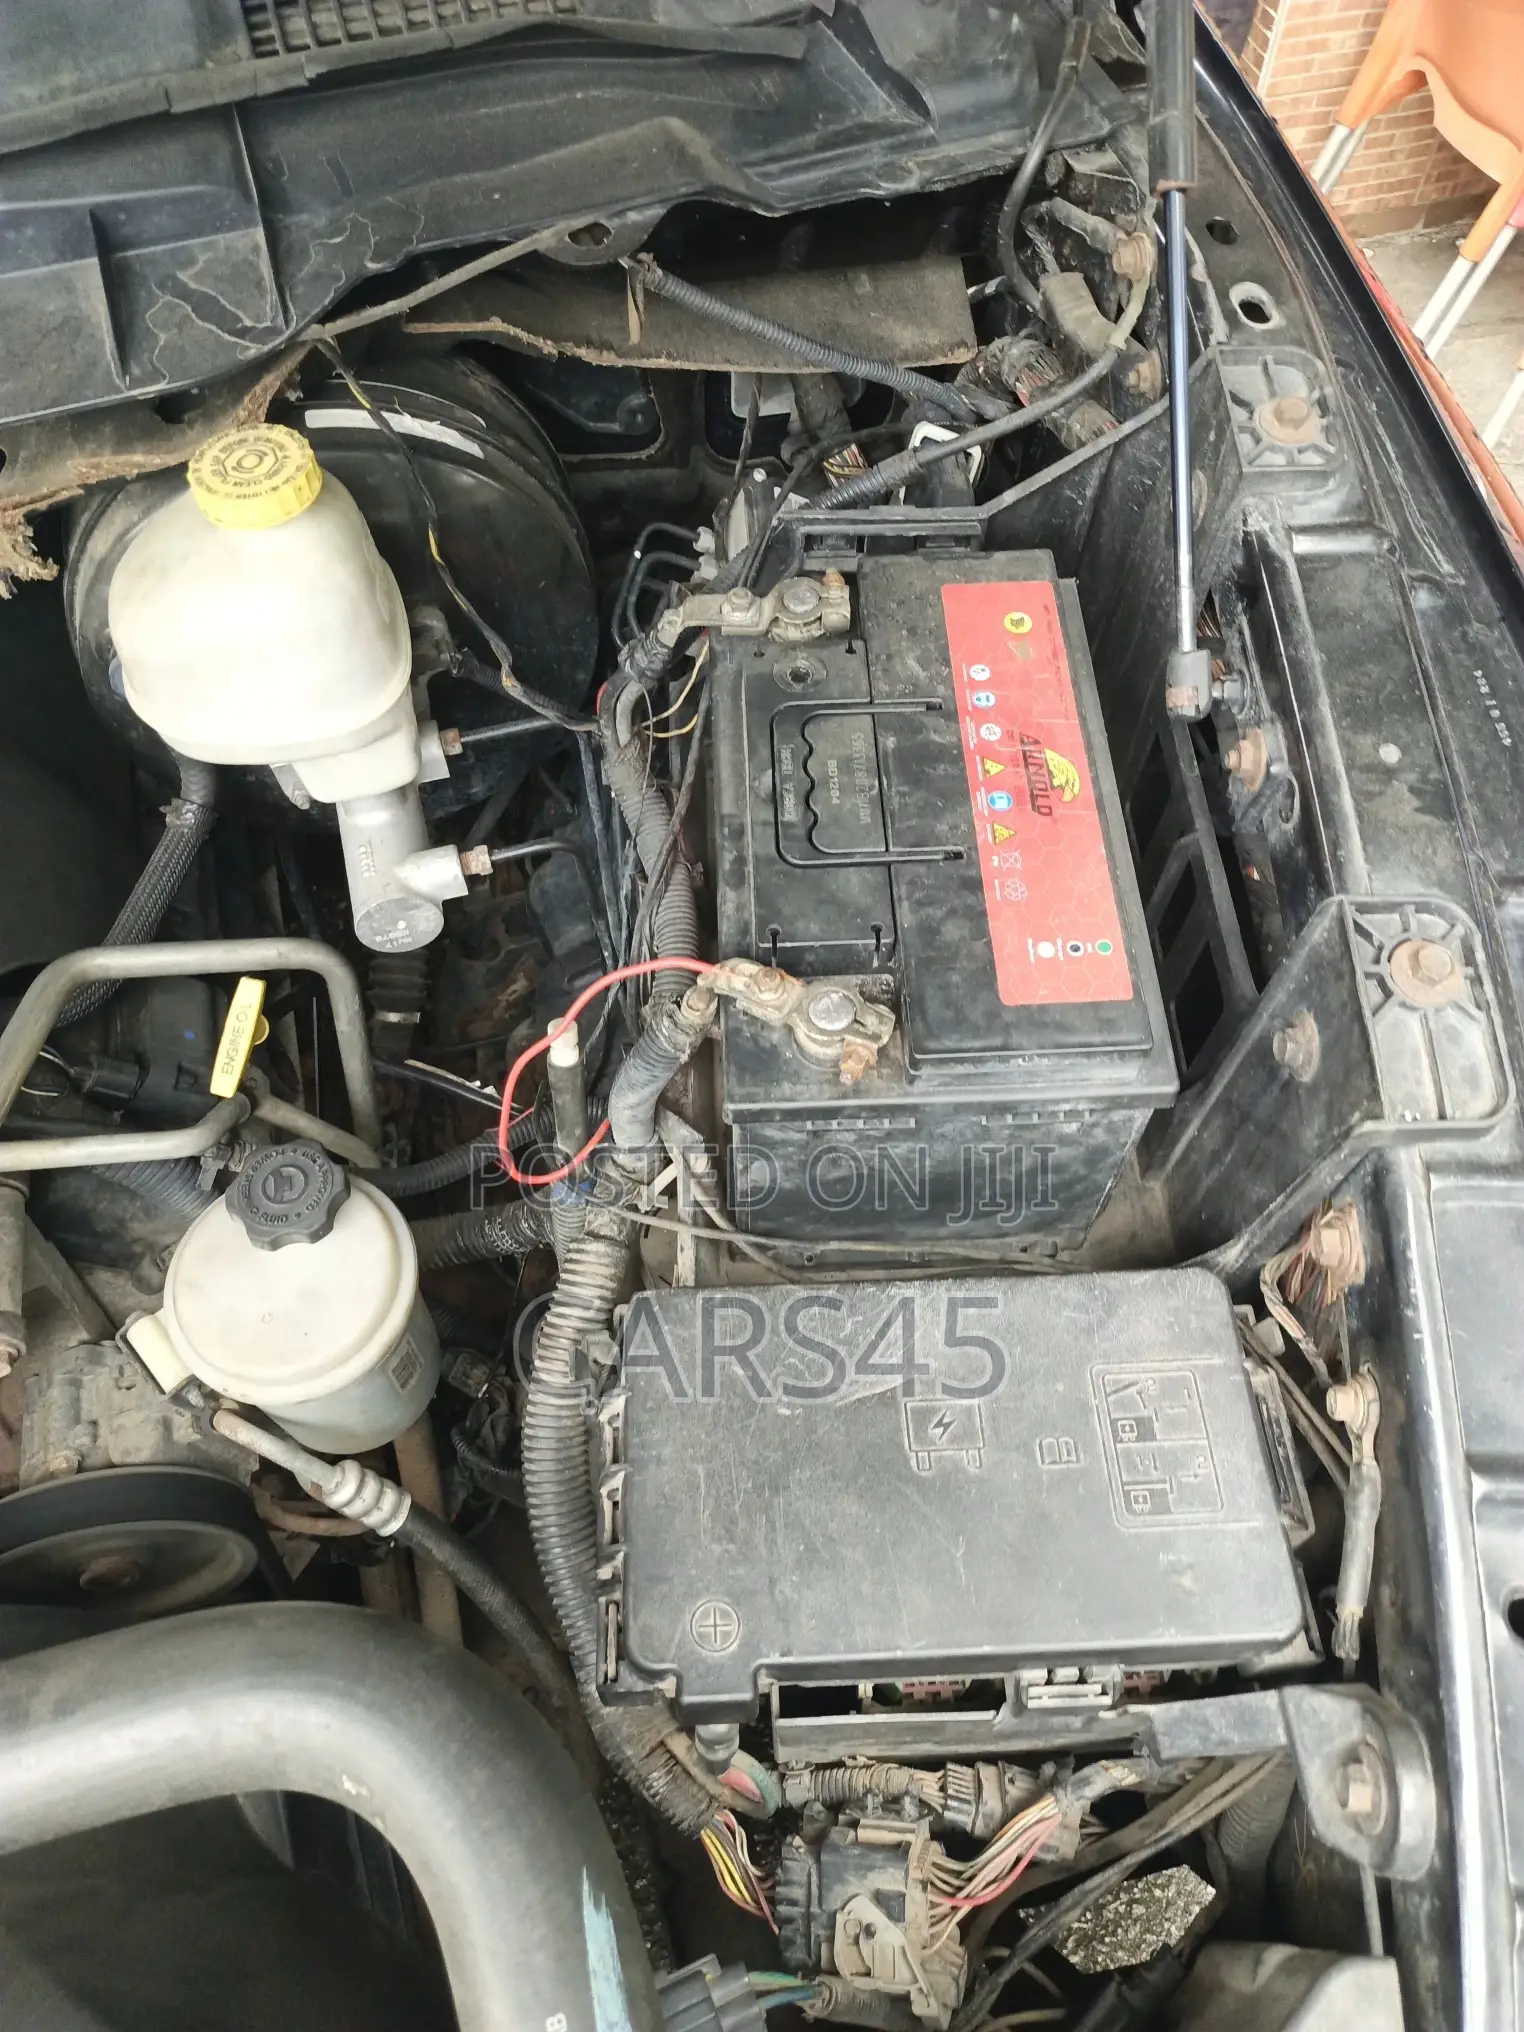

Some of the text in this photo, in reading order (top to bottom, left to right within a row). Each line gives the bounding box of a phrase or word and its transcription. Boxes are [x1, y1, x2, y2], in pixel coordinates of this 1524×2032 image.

[827, 759, 841, 805] BD1204
[221, 1025, 245, 1076] ENGINE
[251, 1148, 285, 1173] POWER
[301, 1149, 319, 1165] USE
[258, 1211, 290, 1226] FLUID
